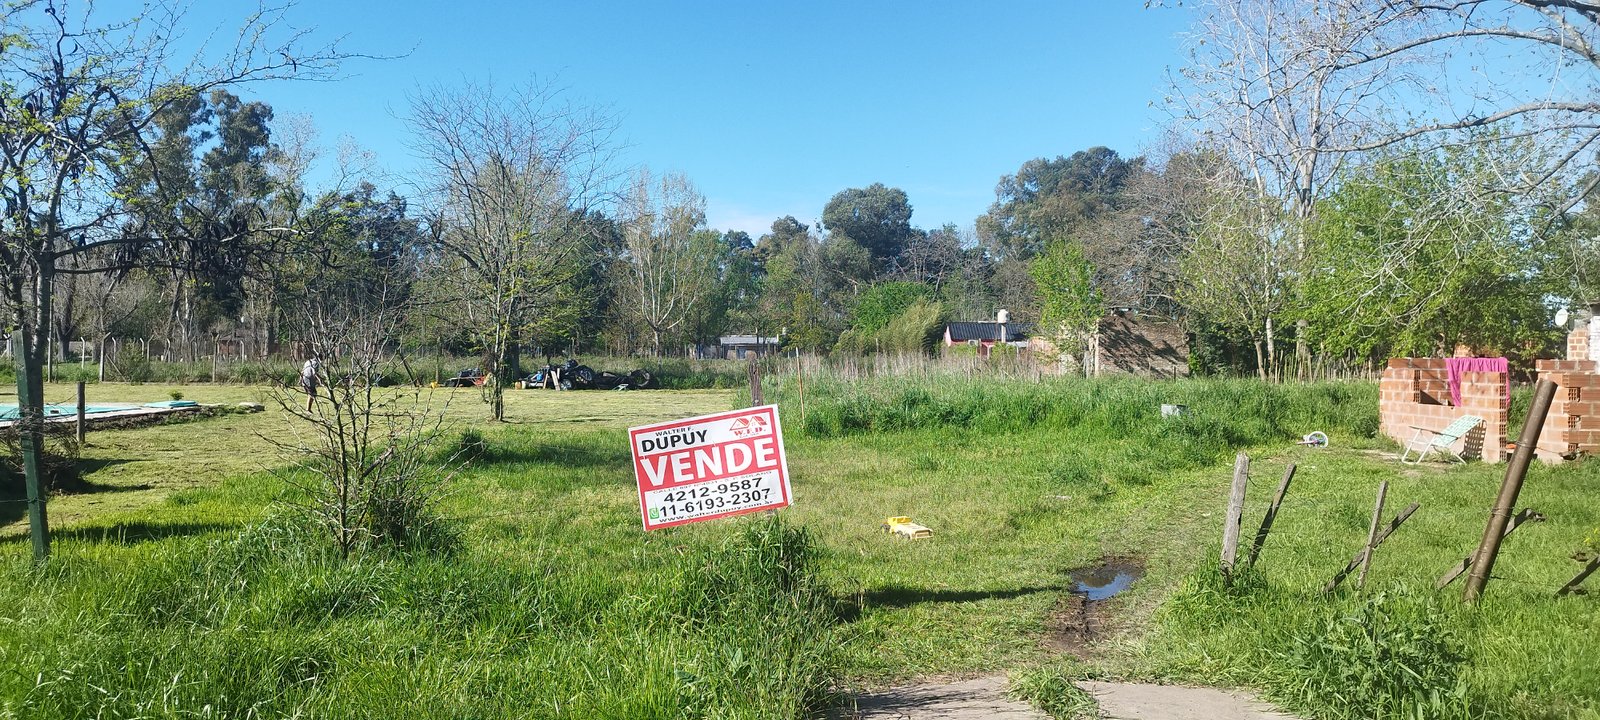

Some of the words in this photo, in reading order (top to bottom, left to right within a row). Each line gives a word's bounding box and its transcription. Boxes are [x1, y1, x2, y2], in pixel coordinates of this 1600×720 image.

[641, 429, 708, 453] DUPUY
[655, 428, 687, 437] WALTER
[640, 437, 778, 487] VENDE
[663, 477, 763, 503] 4212-9587
[659, 488, 771, 518] 11-6193-2307
[659, 500, 774, 523] www.walterdupuy.com.ar
